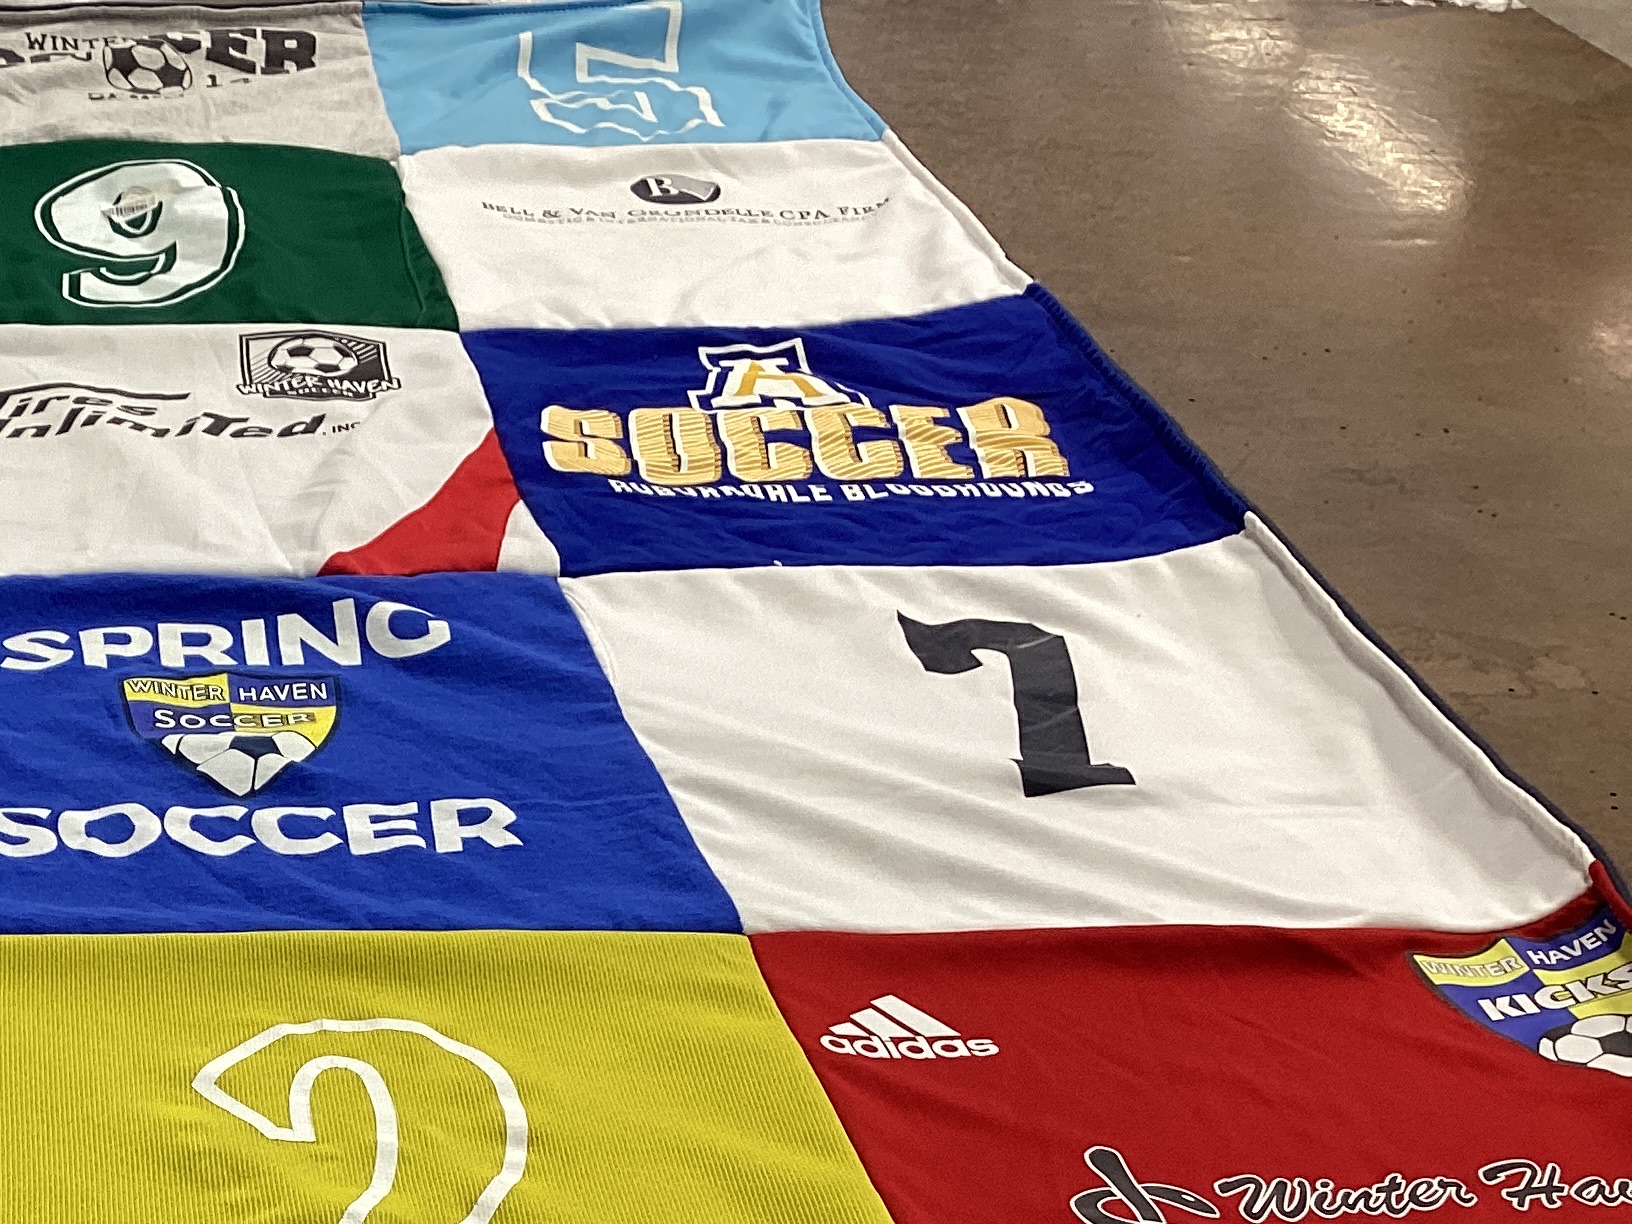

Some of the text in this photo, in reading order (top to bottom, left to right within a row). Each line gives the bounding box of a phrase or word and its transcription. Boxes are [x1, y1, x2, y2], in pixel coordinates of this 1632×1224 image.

[779, 209, 831, 220] CPA
[34, 159, 245, 308] 9
[237, 374, 322, 395] WINTER
[326, 377, 400, 393] HAVEN
[541, 397, 1070, 483] SOCCER
[128, 679, 328, 702] WINTER HAVEN
[153, 708, 315, 730] SOCCER
[1421, 918, 1618, 978] WINTER HAVEN
[819, 1031, 1000, 1060] adidas
[1214, 1172, 1479, 1224] Winter
